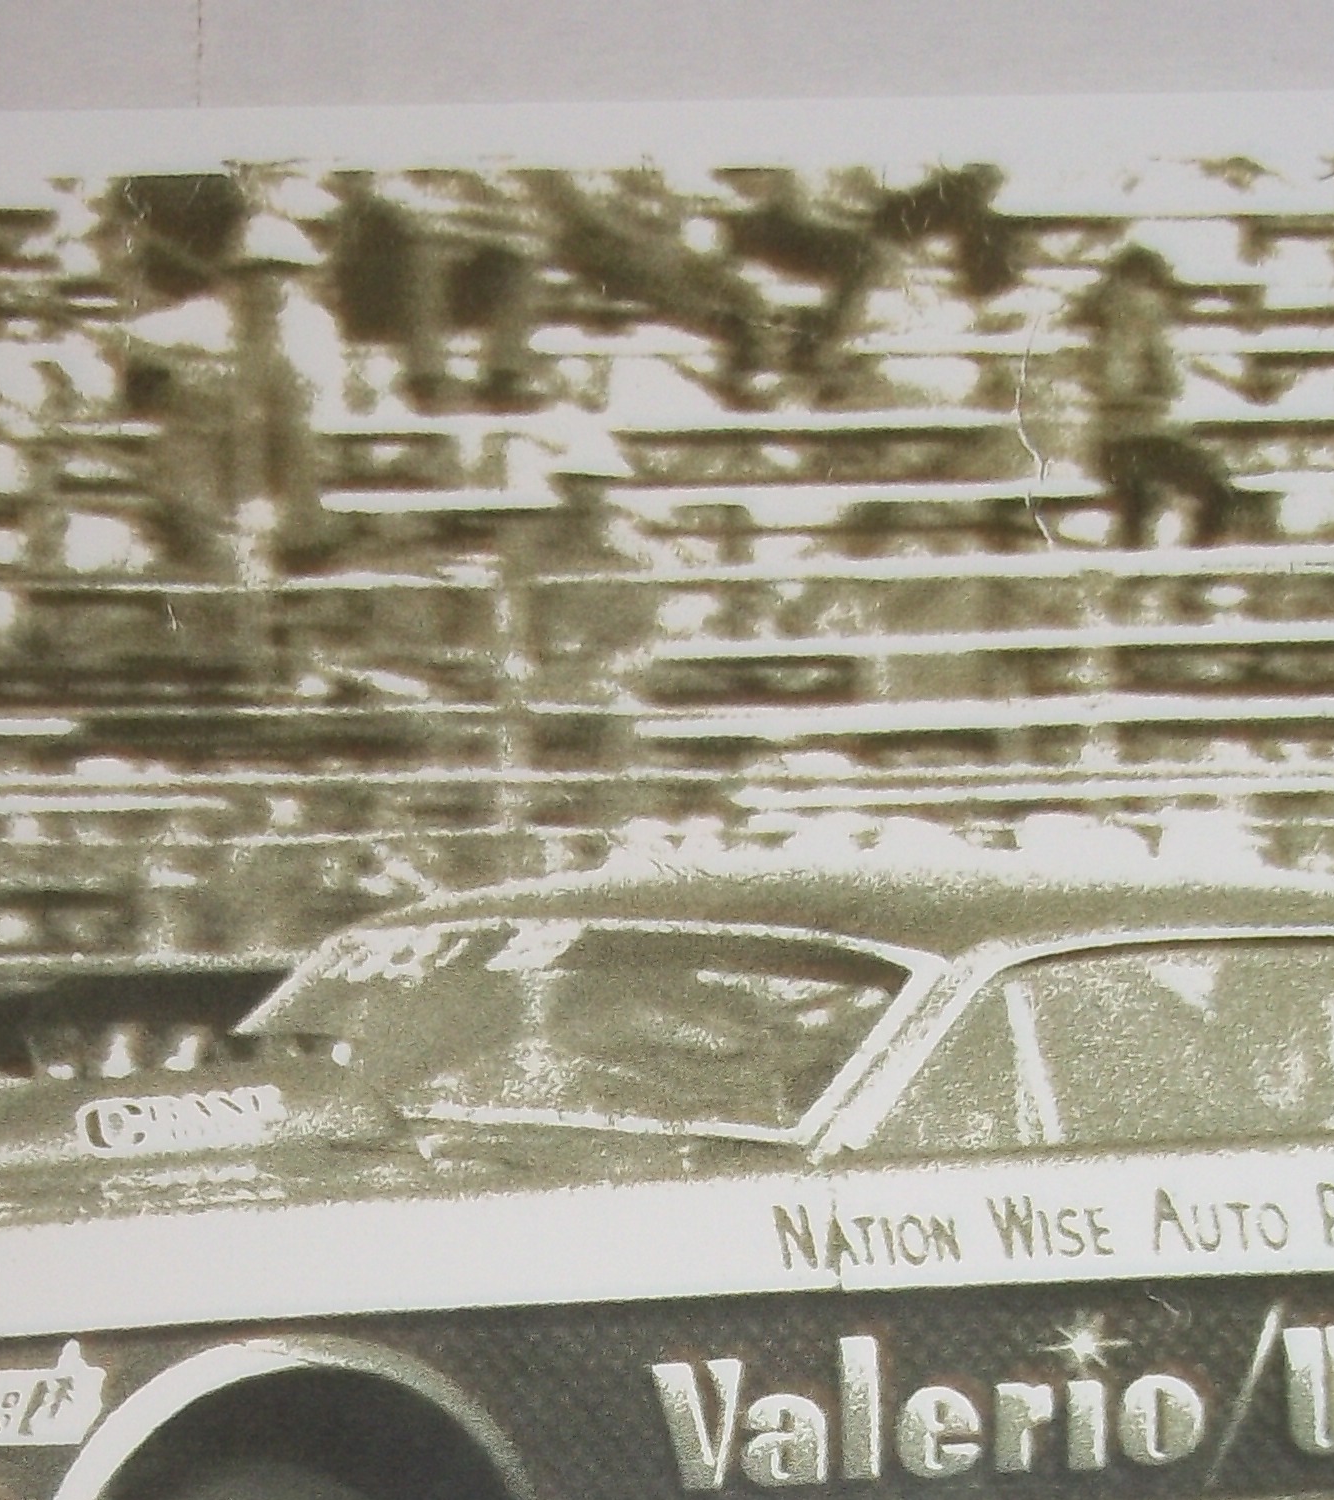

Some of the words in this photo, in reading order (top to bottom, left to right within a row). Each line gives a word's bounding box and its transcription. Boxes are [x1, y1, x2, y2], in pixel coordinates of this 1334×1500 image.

[771, 1202, 962, 1272] NATION
[984, 1194, 1115, 1260] WISE
[1153, 1187, 1289, 1254] AUTO
